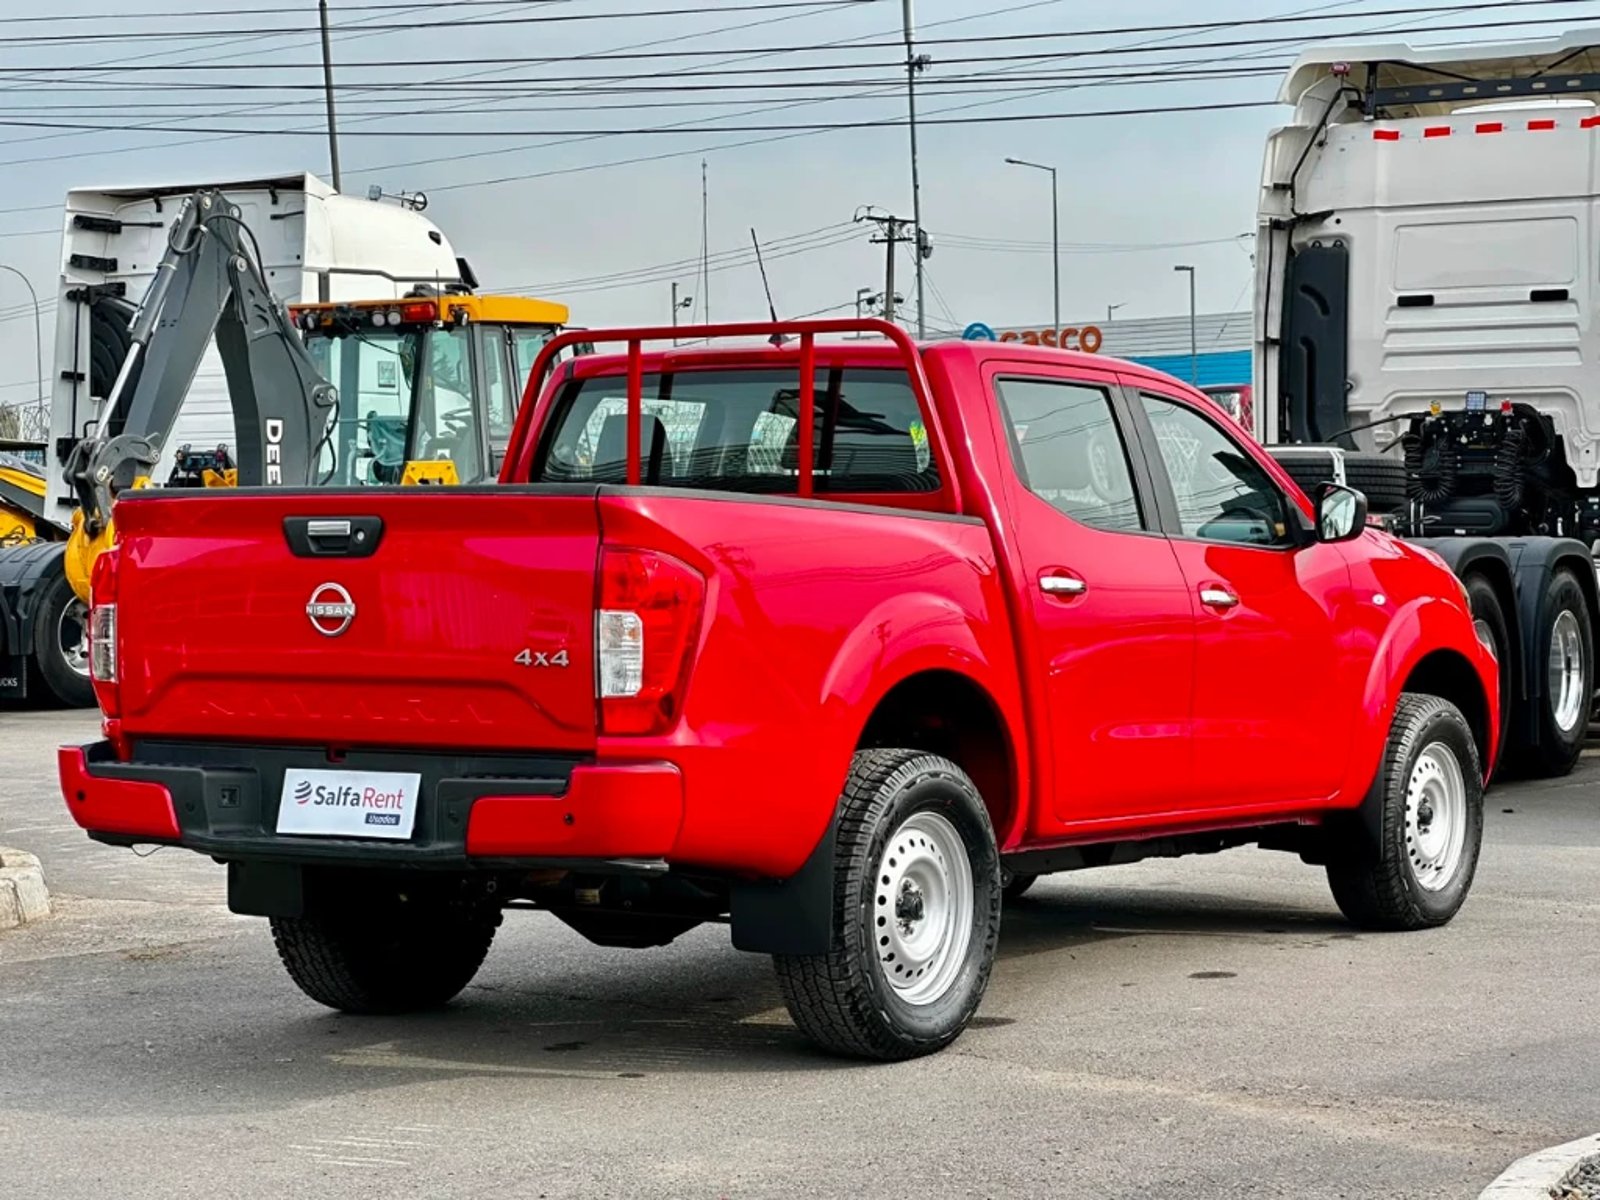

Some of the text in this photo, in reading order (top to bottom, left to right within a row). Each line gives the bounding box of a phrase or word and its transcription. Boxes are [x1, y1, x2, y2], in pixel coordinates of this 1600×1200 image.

[306, 604, 354, 615] NISSAN
[513, 648, 570, 667] 4x4
[313, 785, 405, 810] SalfaRent
